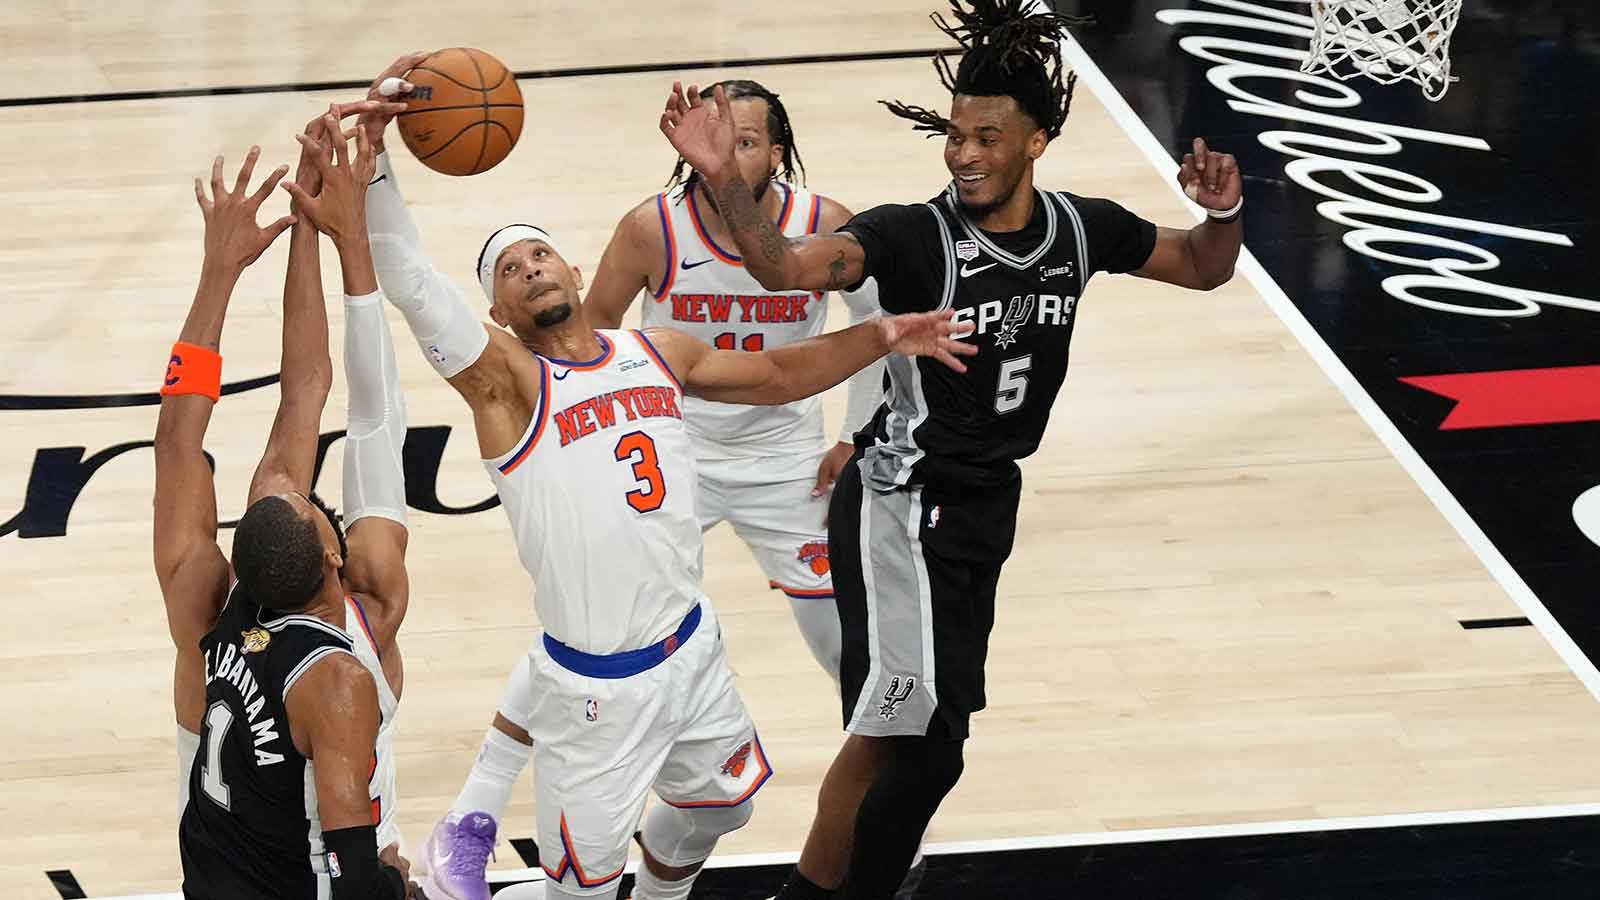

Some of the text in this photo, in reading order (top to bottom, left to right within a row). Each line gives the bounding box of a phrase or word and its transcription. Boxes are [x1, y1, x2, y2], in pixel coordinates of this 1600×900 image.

[1044, 265, 1070, 277] LEDGER
[671, 294, 810, 323] NEW YORK
[993, 353, 1033, 416] 5
[553, 385, 683, 448] NEW YORK
[614, 430, 667, 514] 3
[201, 699, 235, 812] 1
